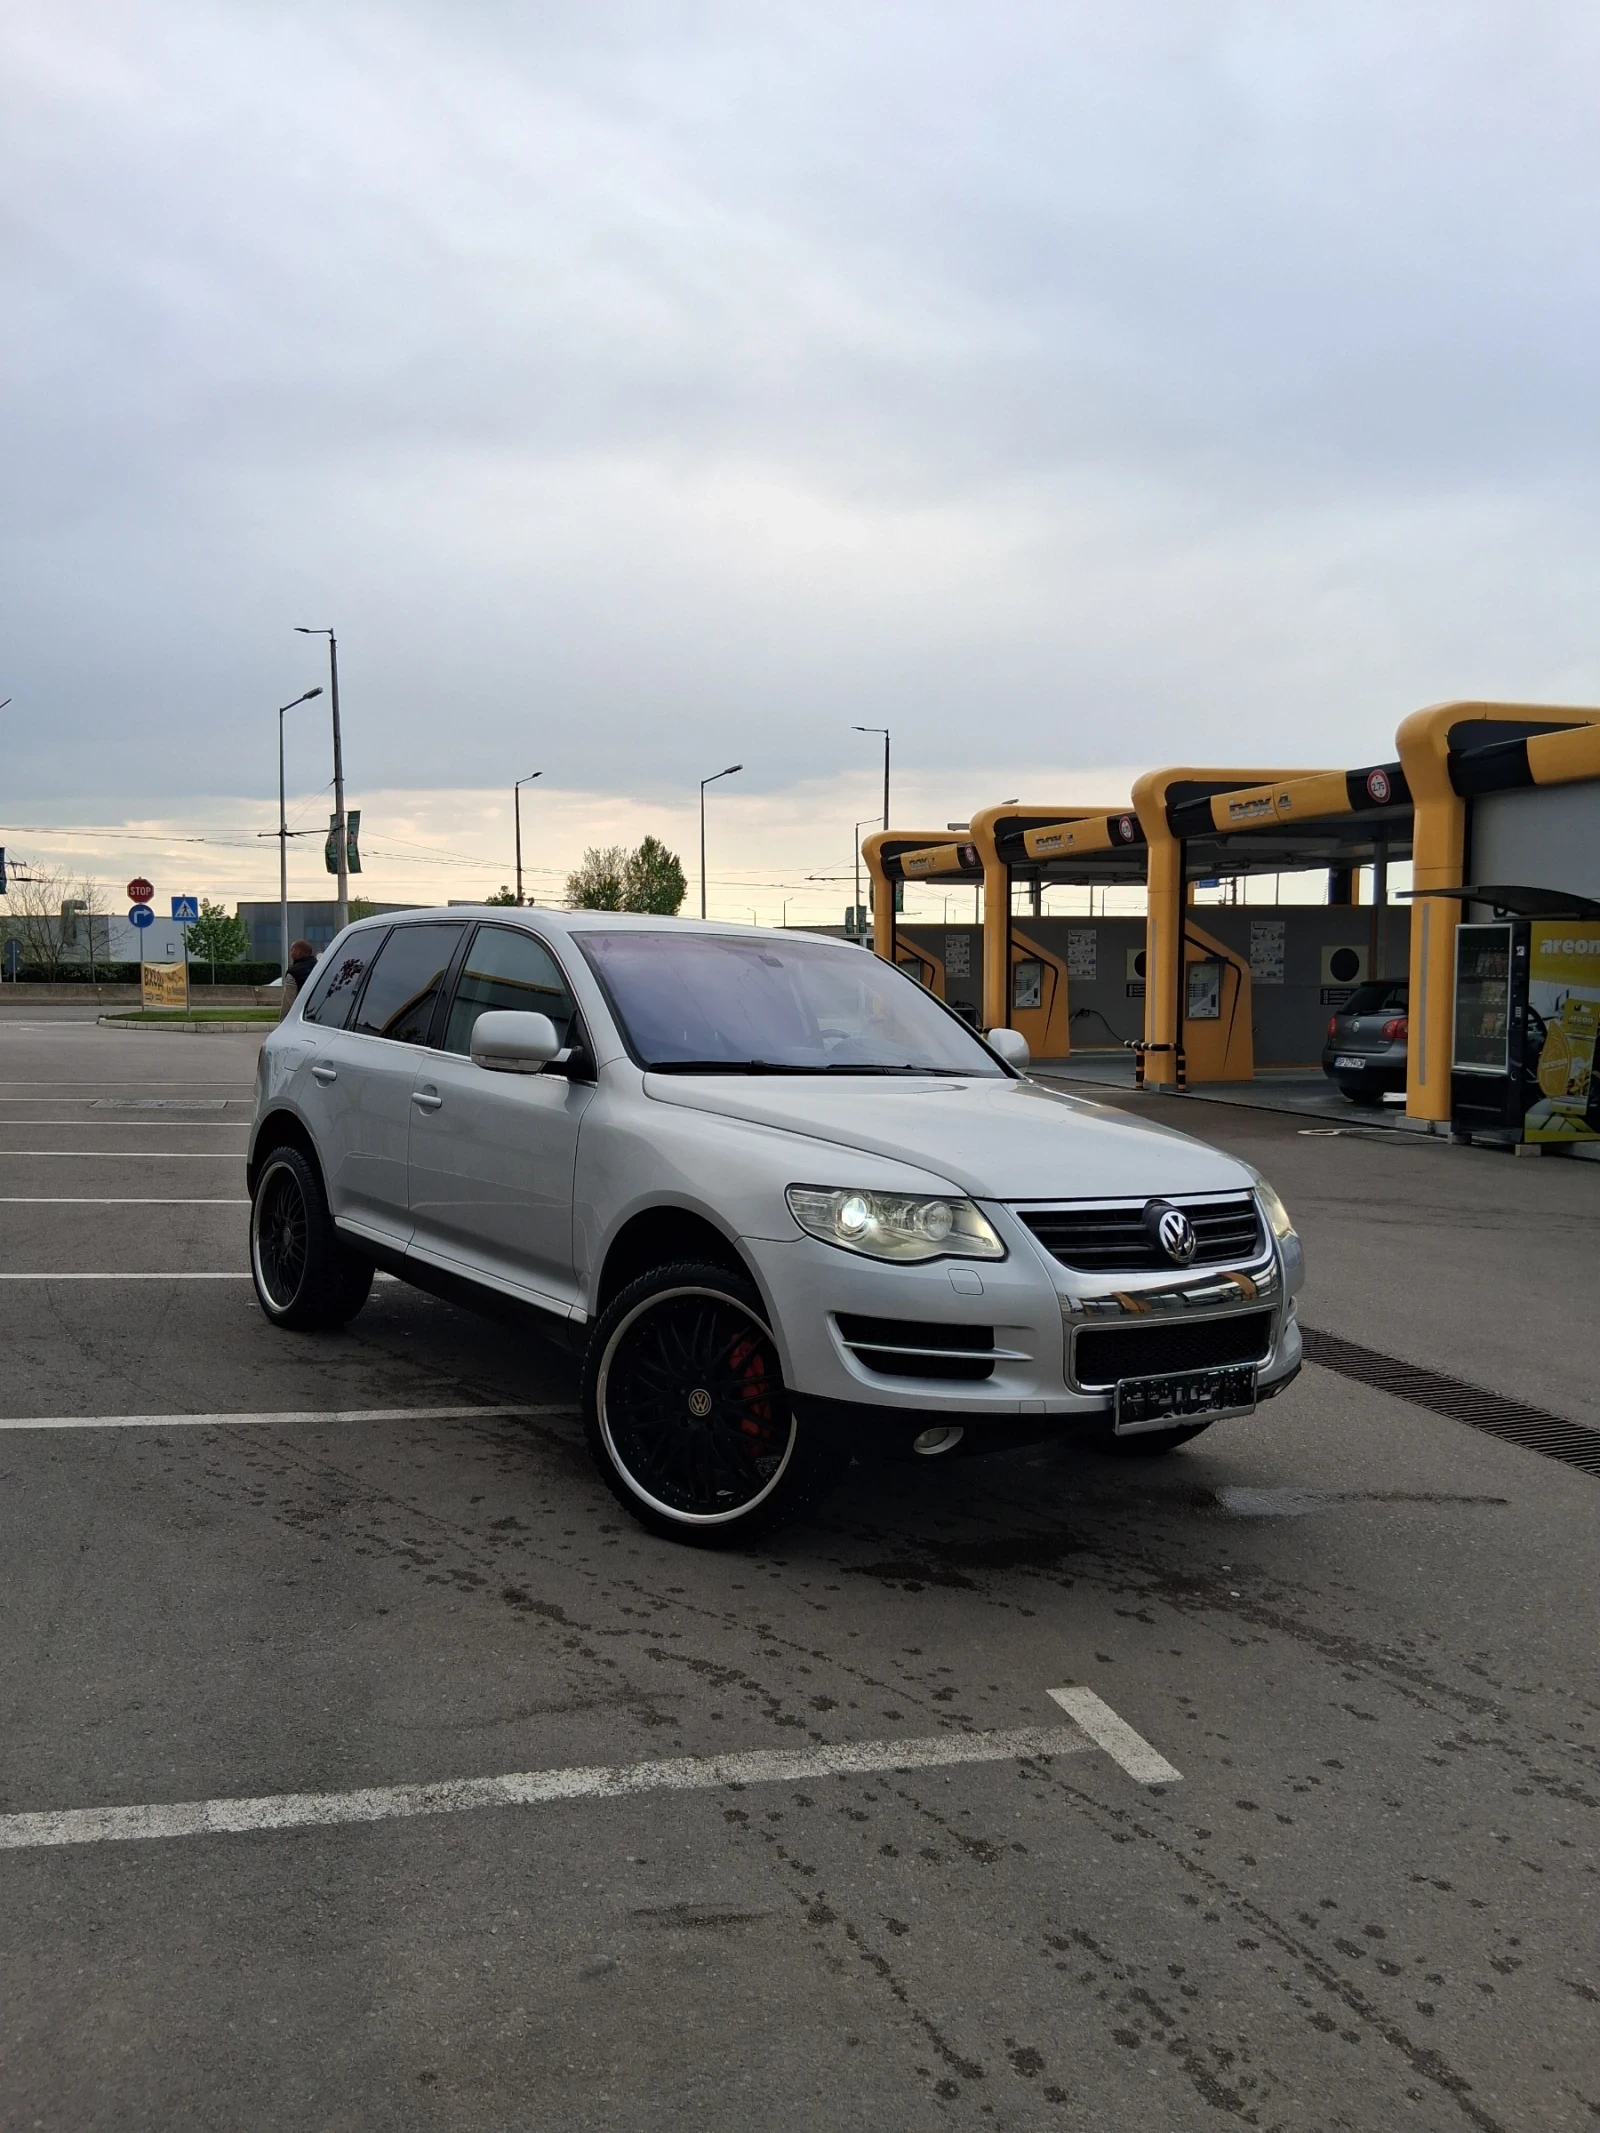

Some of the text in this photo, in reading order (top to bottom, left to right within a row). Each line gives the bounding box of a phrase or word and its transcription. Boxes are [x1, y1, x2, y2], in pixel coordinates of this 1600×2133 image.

[1229, 792, 1292, 821] box 4
[130, 886, 151, 896] STOP
[1540, 938, 1600, 955] areon
